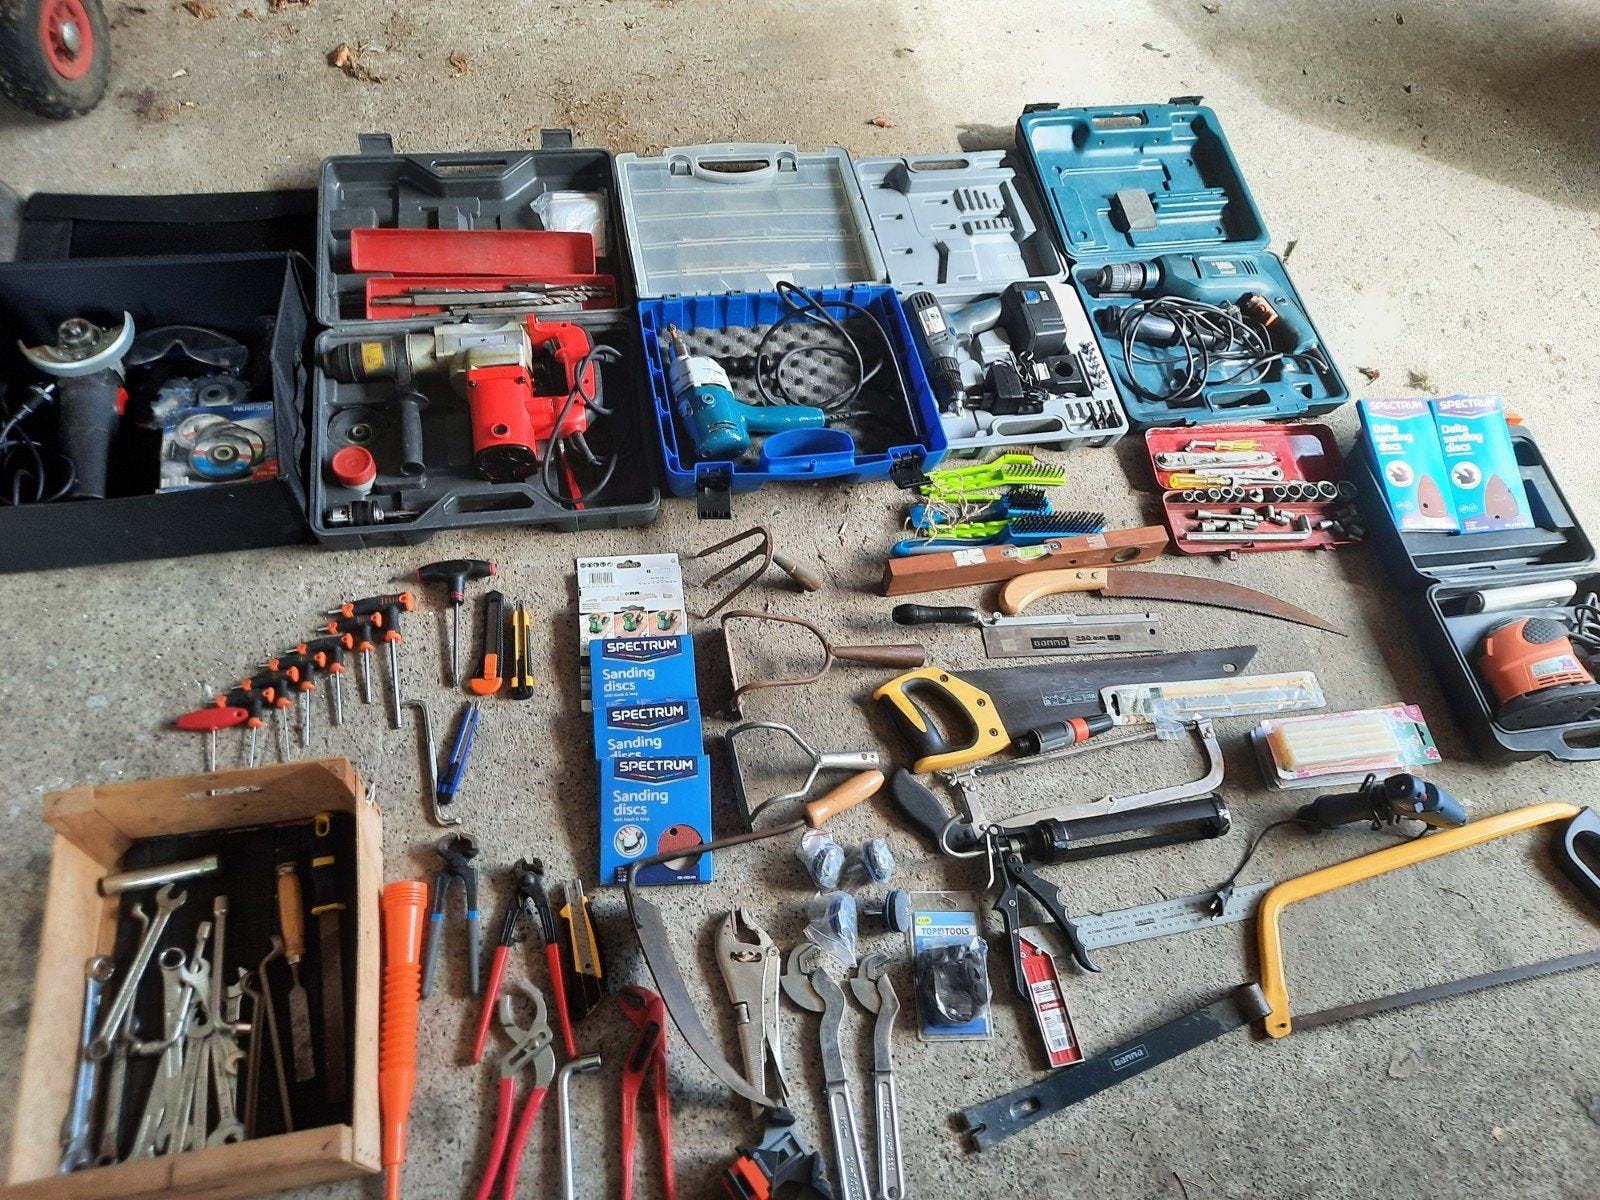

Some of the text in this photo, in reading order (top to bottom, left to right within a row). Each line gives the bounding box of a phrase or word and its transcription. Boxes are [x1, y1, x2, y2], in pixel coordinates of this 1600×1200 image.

[1369, 401, 1423, 410] SPECTRUM
[1439, 399, 1496, 410] SPECTRUM
[1441, 423, 1469, 434] Delta
[1443, 432, 1483, 444] sanding
[1445, 442, 1471, 453] discs
[606, 639, 677, 653] SPECTRUM
[602, 667, 655, 680] Sanding
[603, 681, 636, 692] discs
[611, 705, 684, 722] SPECTRUM
[607, 735, 662, 751] Sanding
[619, 759, 693, 772] SPECTRUM
[612, 788, 669, 805] Sanding
[613, 803, 647, 816] discs
